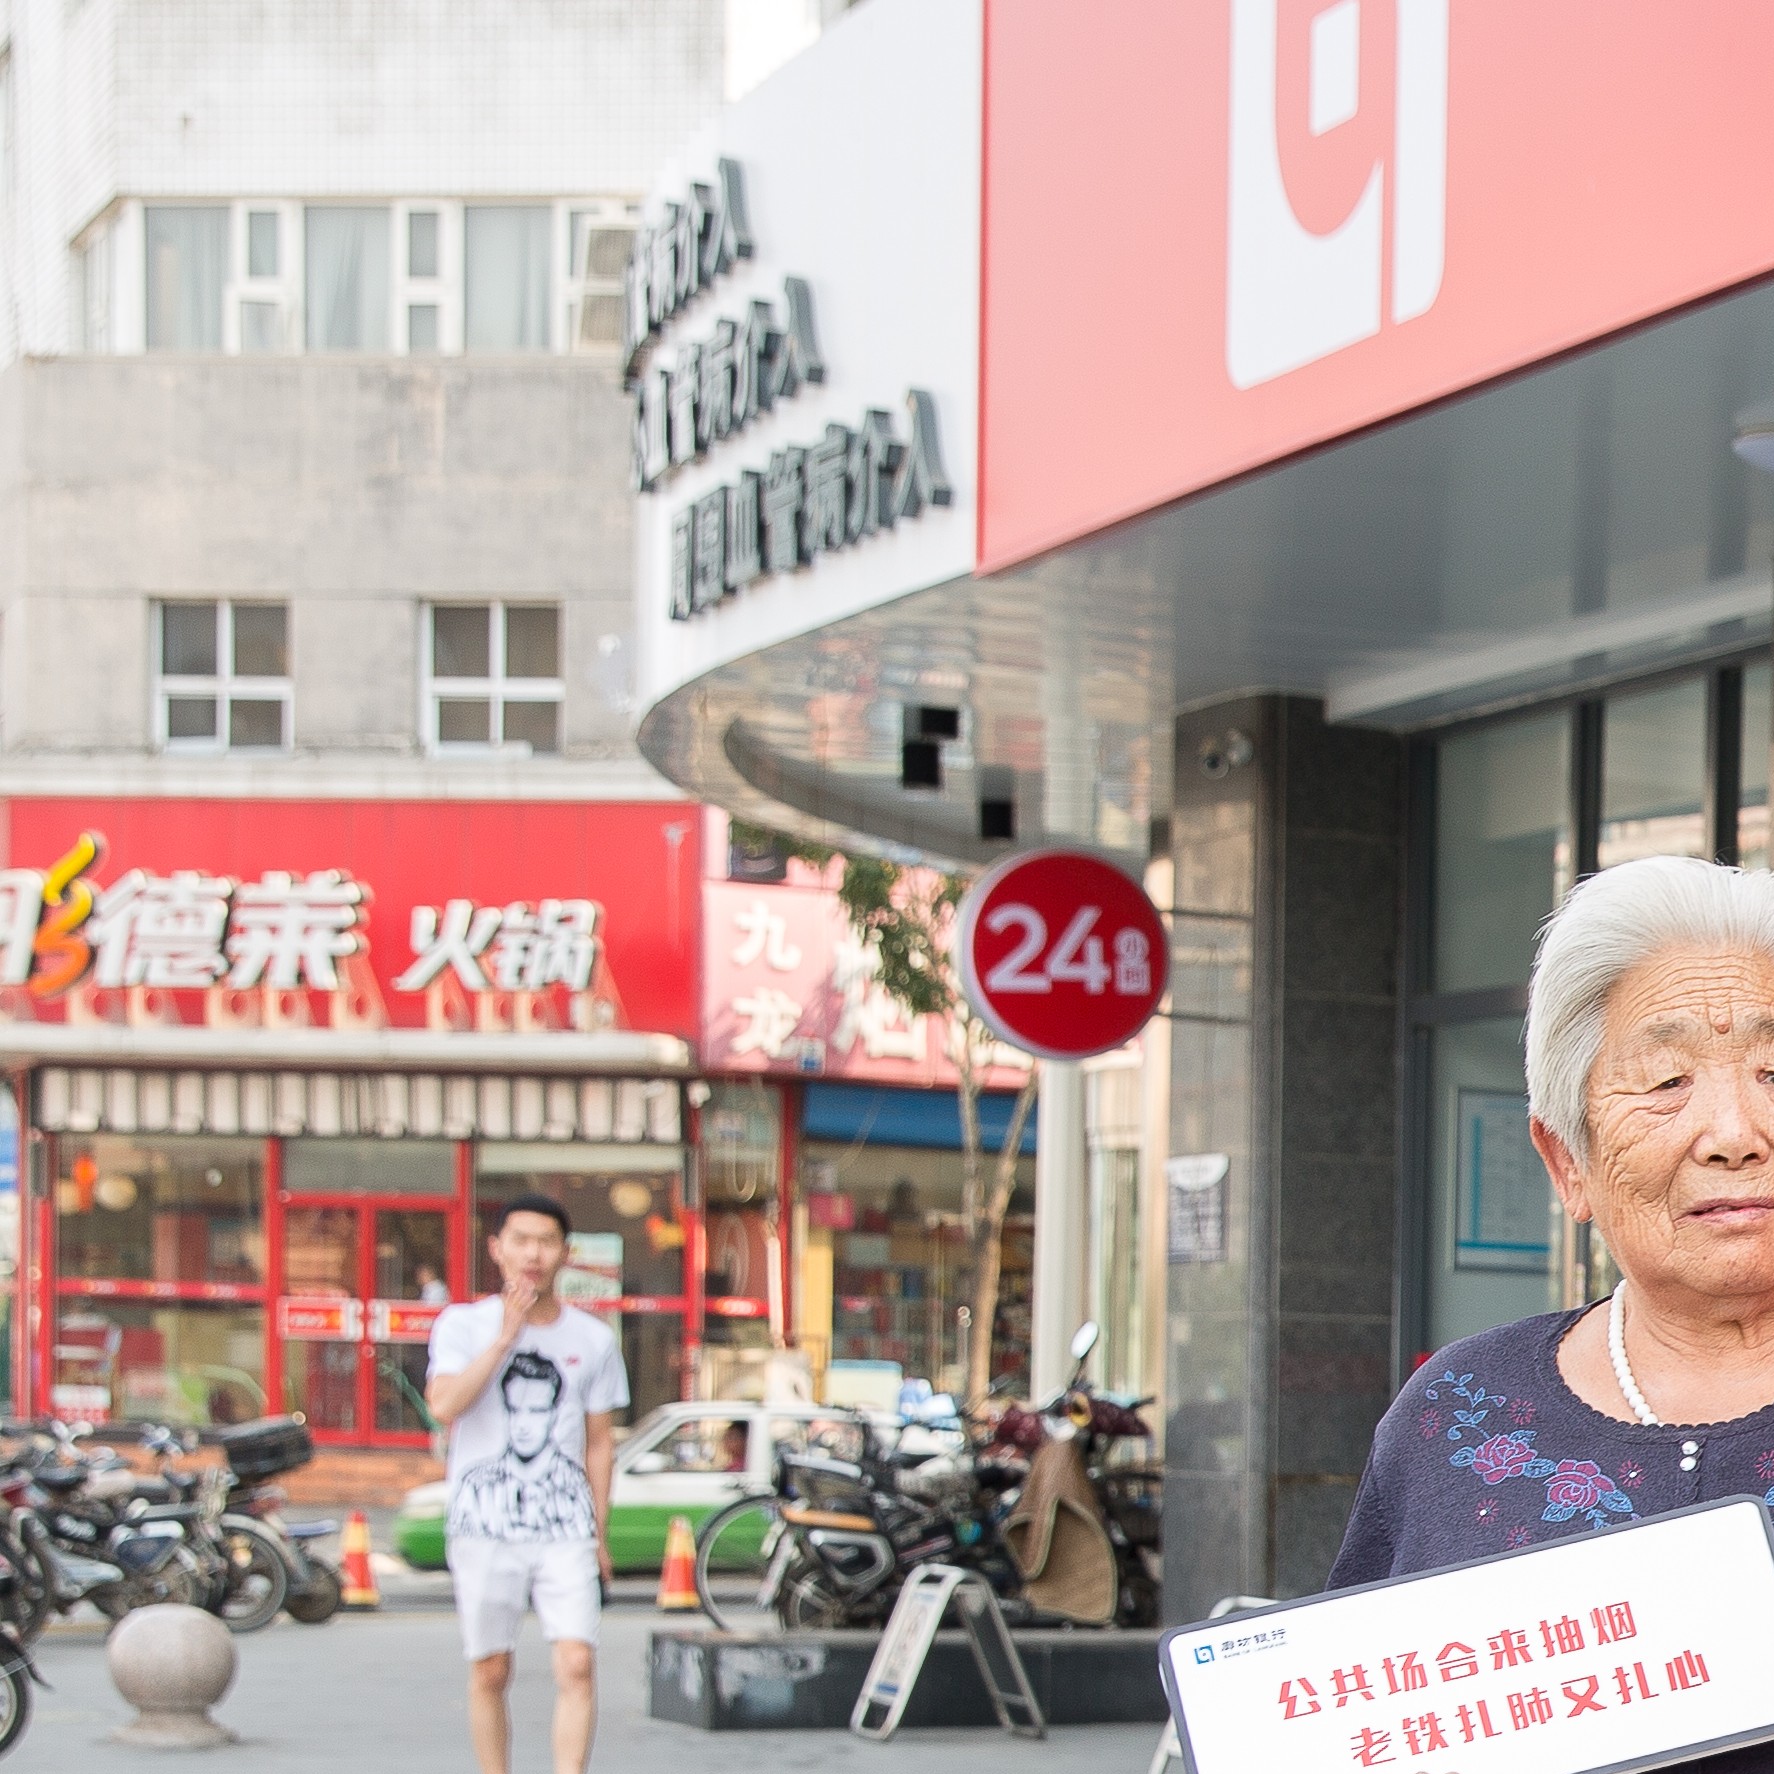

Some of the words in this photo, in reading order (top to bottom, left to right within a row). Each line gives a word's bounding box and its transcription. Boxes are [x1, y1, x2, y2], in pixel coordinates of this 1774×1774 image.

[392, 899, 601, 992] 火锅
[1277, 1601, 1638, 1720] 公共场合来抽烟
[1349, 1650, 1711, 1767] 老铁扎肺又扎心
